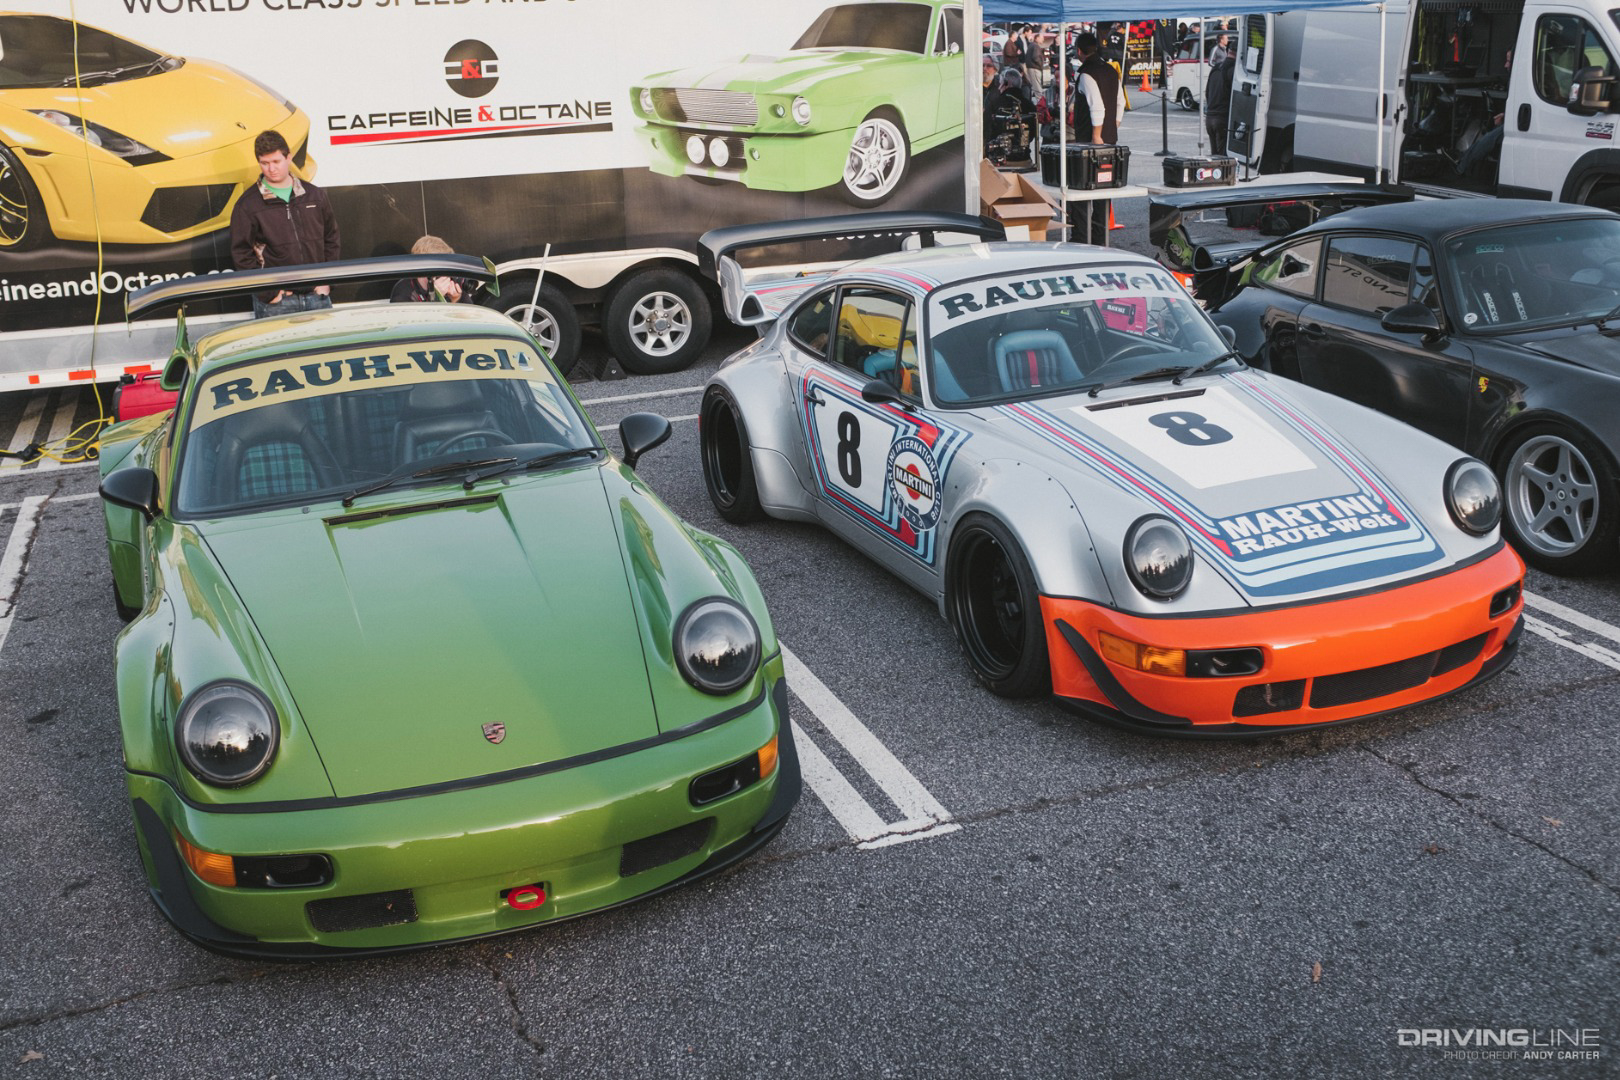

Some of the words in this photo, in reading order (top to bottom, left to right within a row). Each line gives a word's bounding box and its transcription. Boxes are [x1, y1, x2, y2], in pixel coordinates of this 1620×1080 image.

[327, 108, 473, 131] CAFFEINE
[499, 99, 613, 122] OCTANE
[938, 272, 1178, 320] RAUH-Welt
[210, 348, 534, 410] RAUH-Welt
[838, 411, 861, 488] 8
[1148, 411, 1233, 446] 8
[895, 439, 940, 486] INTERNATIONAL
[895, 467, 932, 498] MARTINI
[1218, 494, 1381, 540] MARTINI
[1231, 513, 1397, 555] RAUH-Welt
